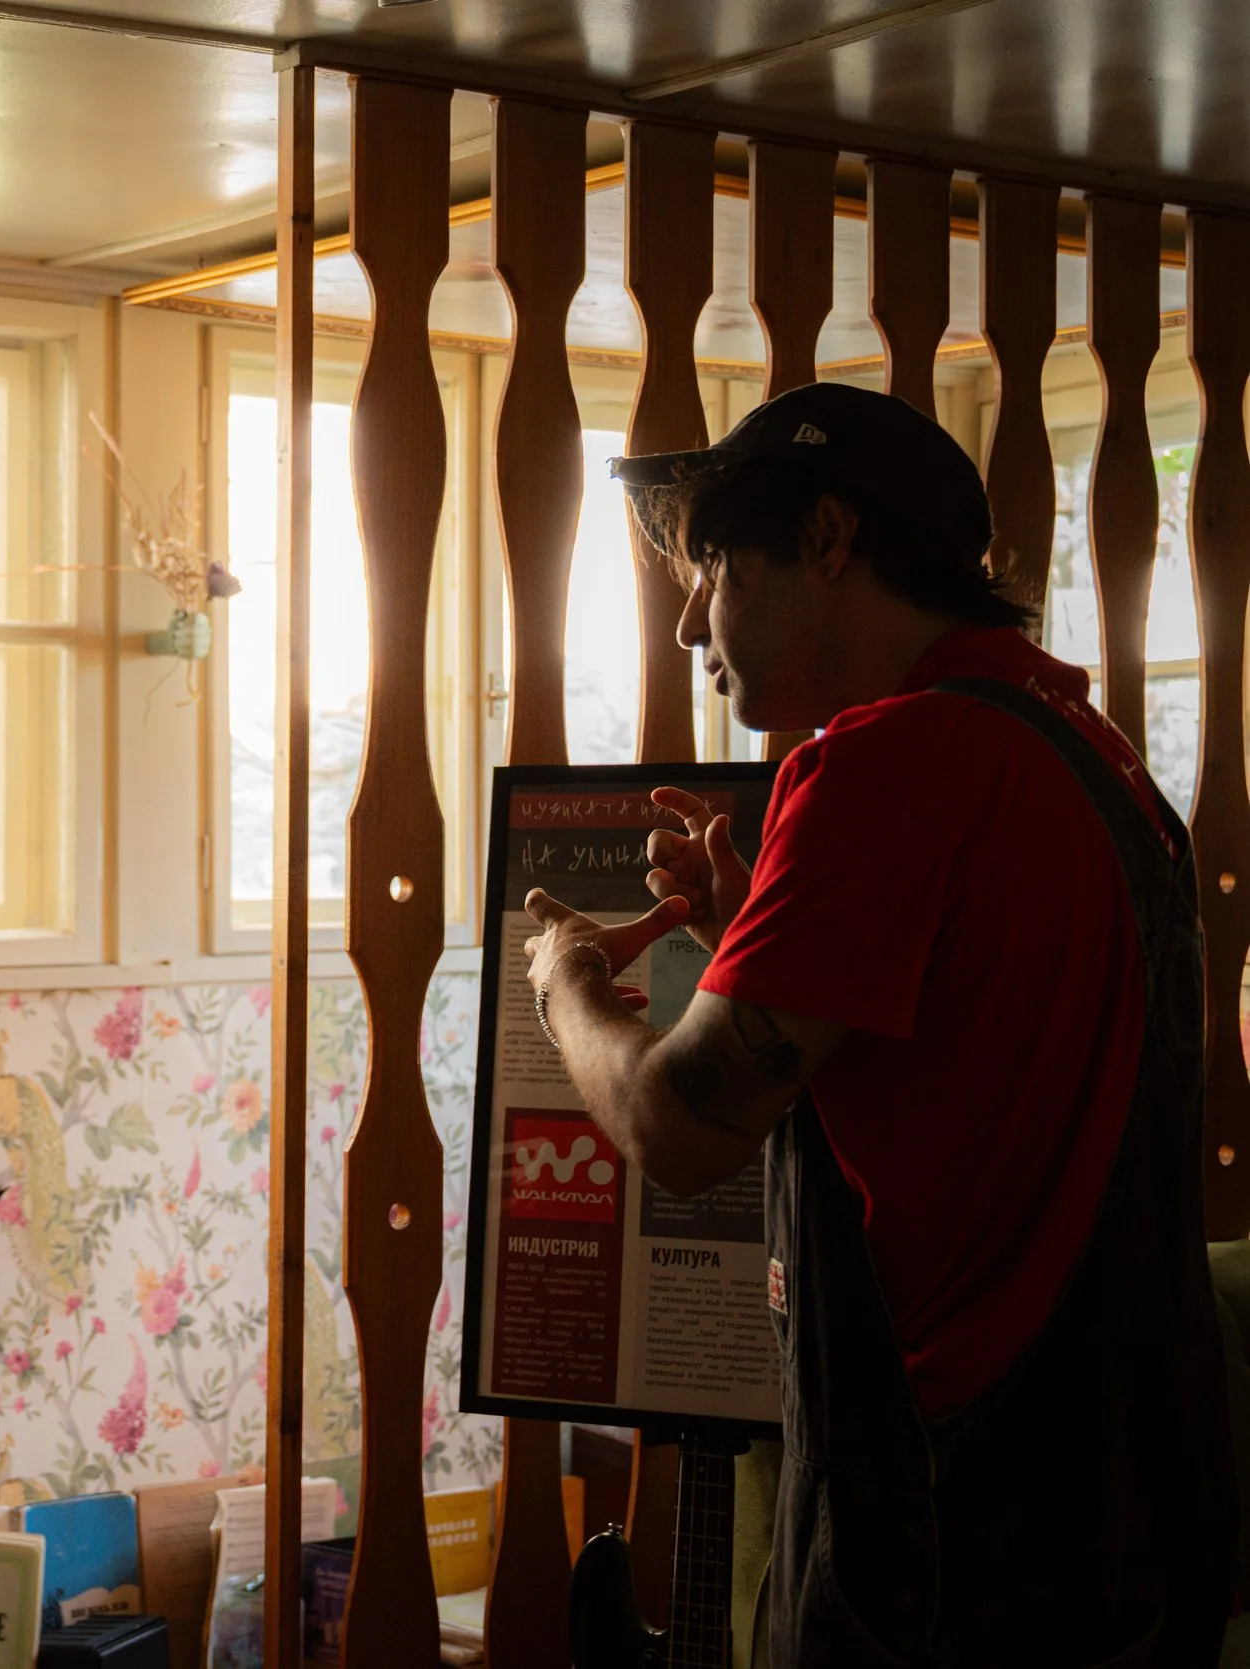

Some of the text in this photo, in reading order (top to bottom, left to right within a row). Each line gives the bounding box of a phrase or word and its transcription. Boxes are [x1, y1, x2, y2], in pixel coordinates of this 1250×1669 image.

[522, 839, 556, 873] НА
[668, 940, 708, 953] TPS-L
[513, 1188, 613, 1204] WALKMAN
[508, 1236, 599, 1258] ИНДУСТРИЯ
[651, 1247, 720, 1269] КУЛТУРА
